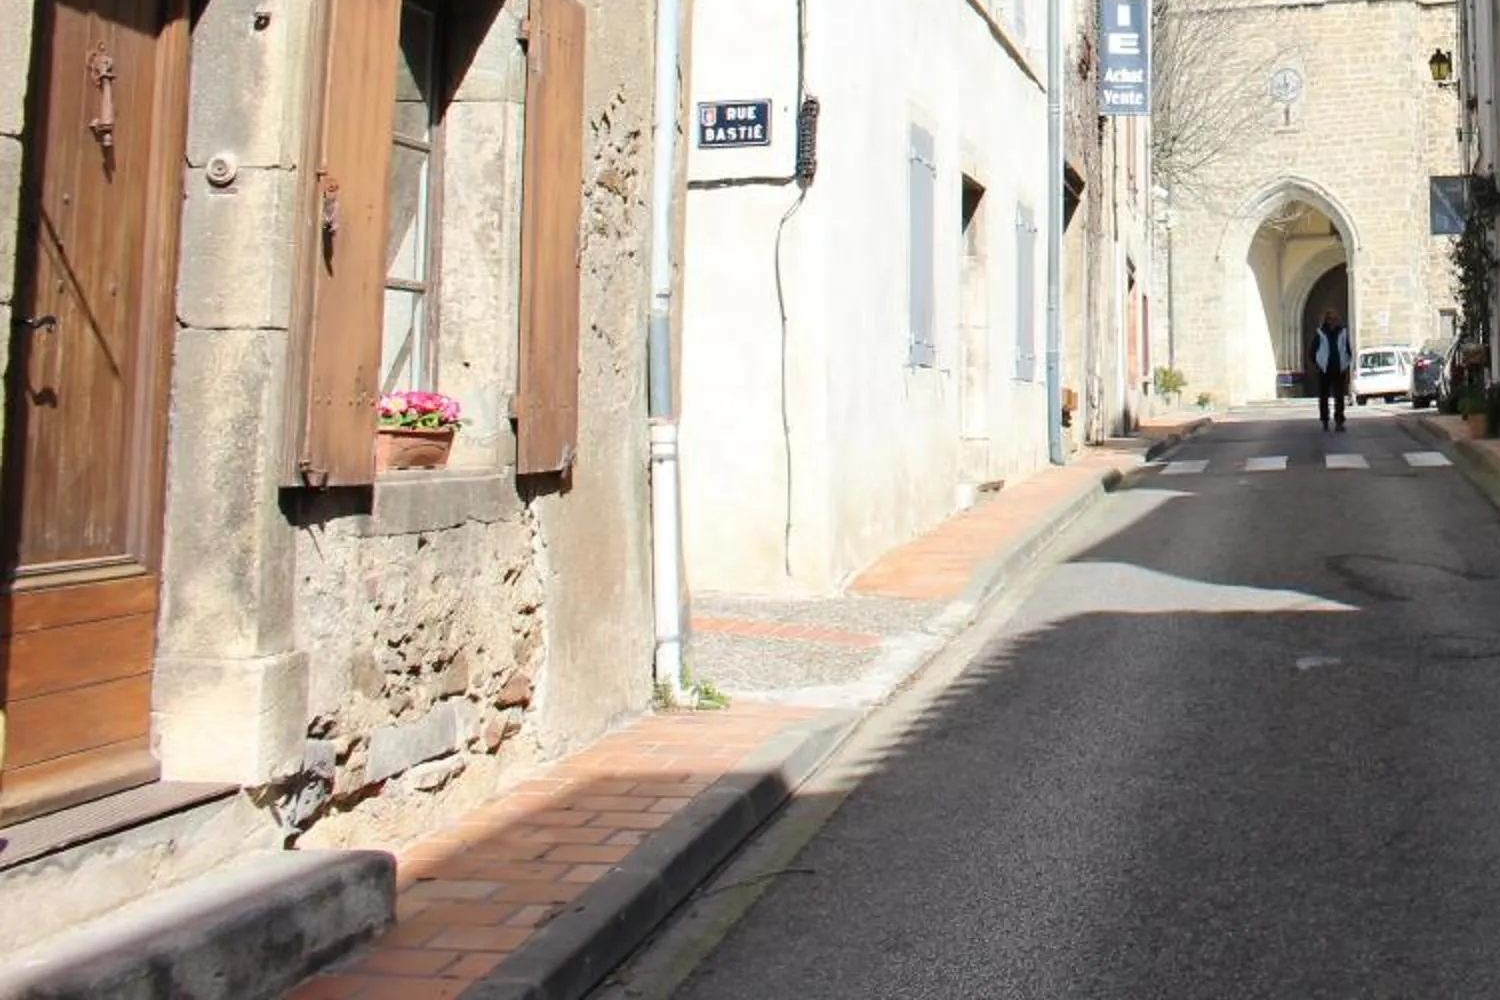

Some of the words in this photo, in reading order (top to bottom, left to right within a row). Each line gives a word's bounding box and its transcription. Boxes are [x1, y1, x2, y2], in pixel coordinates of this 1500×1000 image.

[1103, 67, 1144, 83] Achat
[1103, 89, 1144, 105] Vente
[725, 105, 757, 121] RUE
